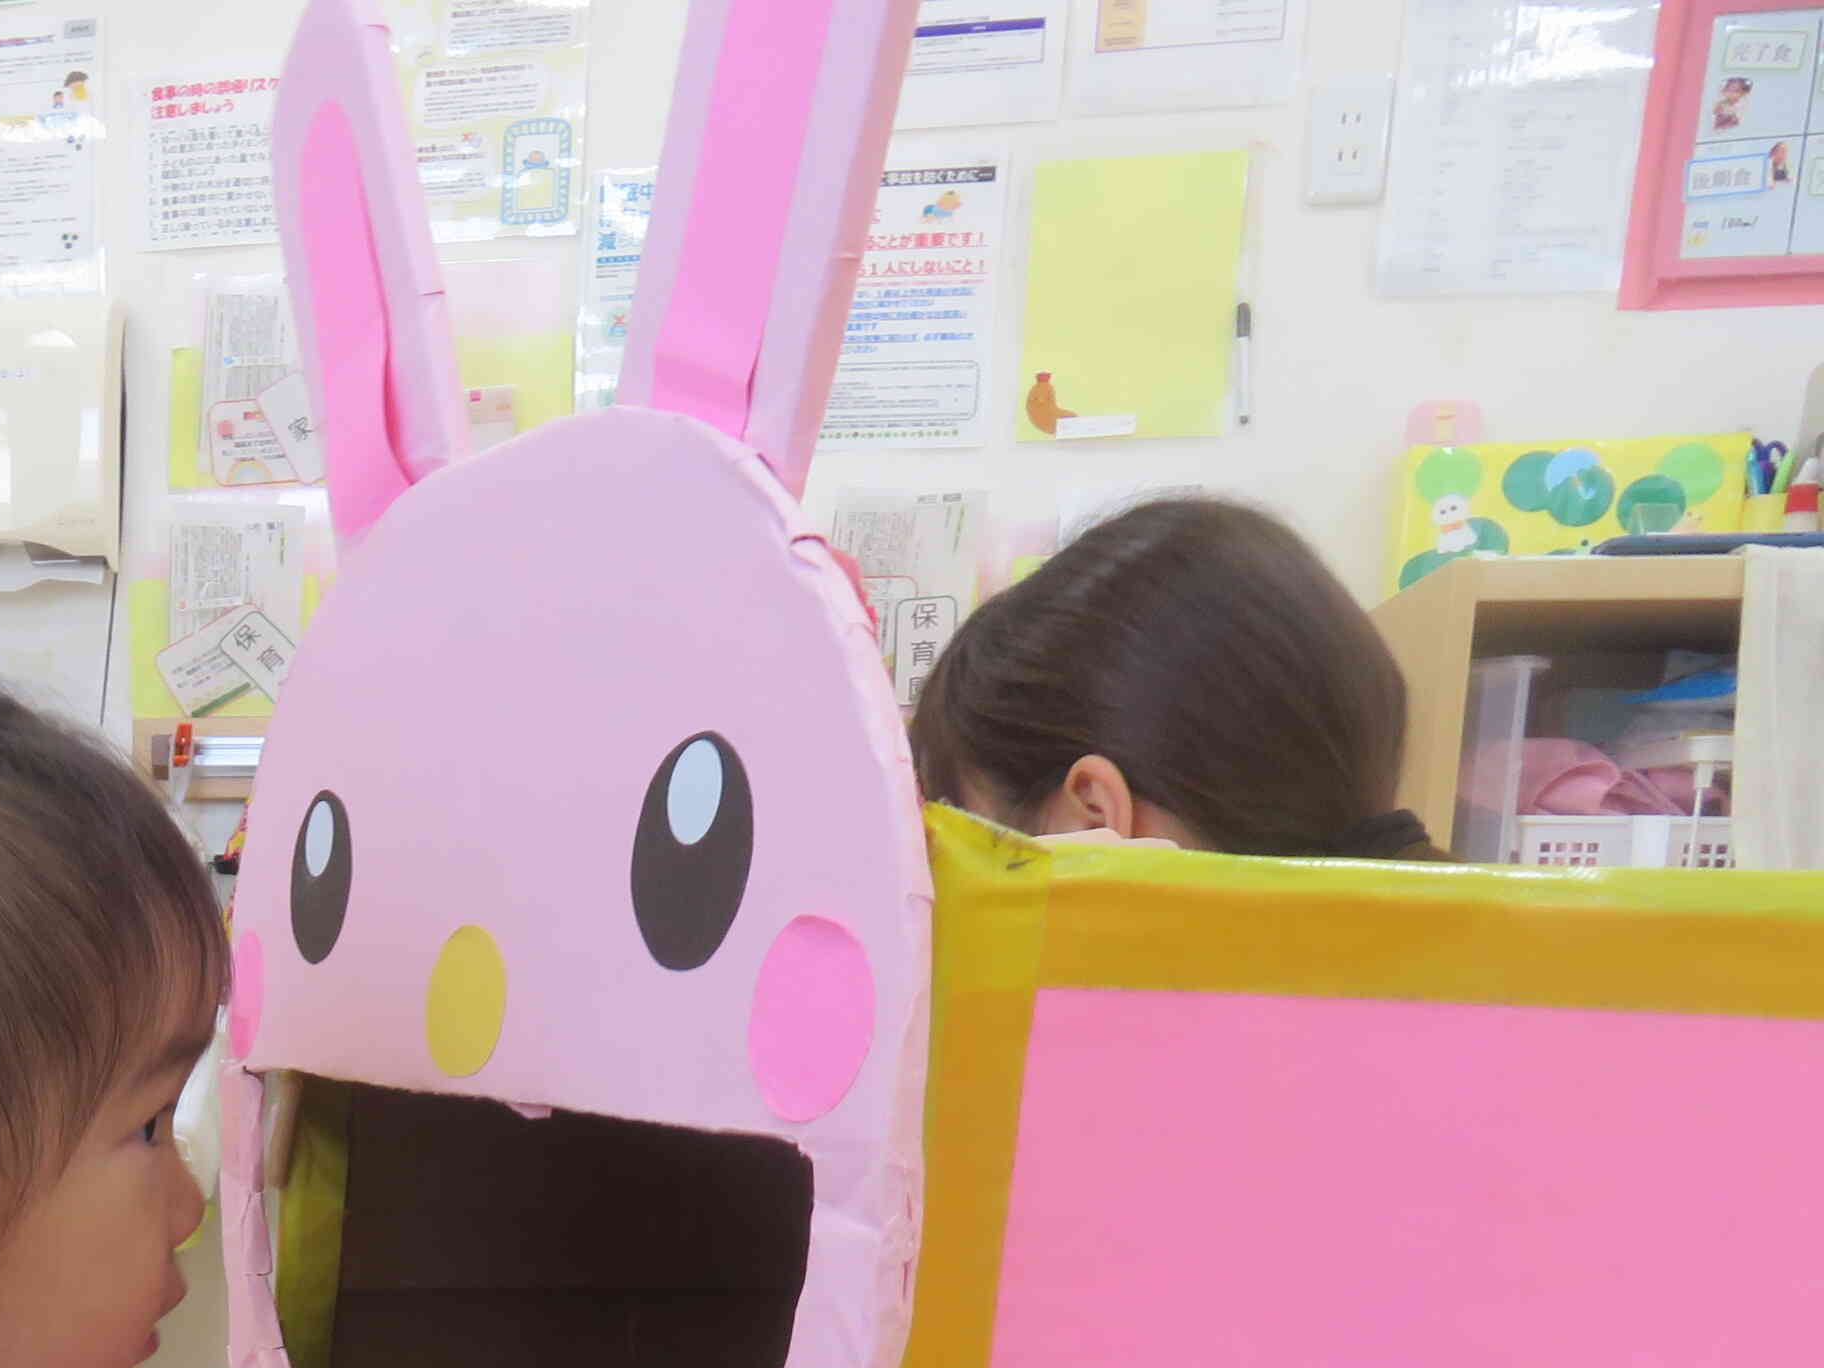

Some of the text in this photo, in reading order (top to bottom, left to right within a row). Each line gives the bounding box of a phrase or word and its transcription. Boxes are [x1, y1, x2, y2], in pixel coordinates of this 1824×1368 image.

[151, 99, 236, 121] 注意しましょう
